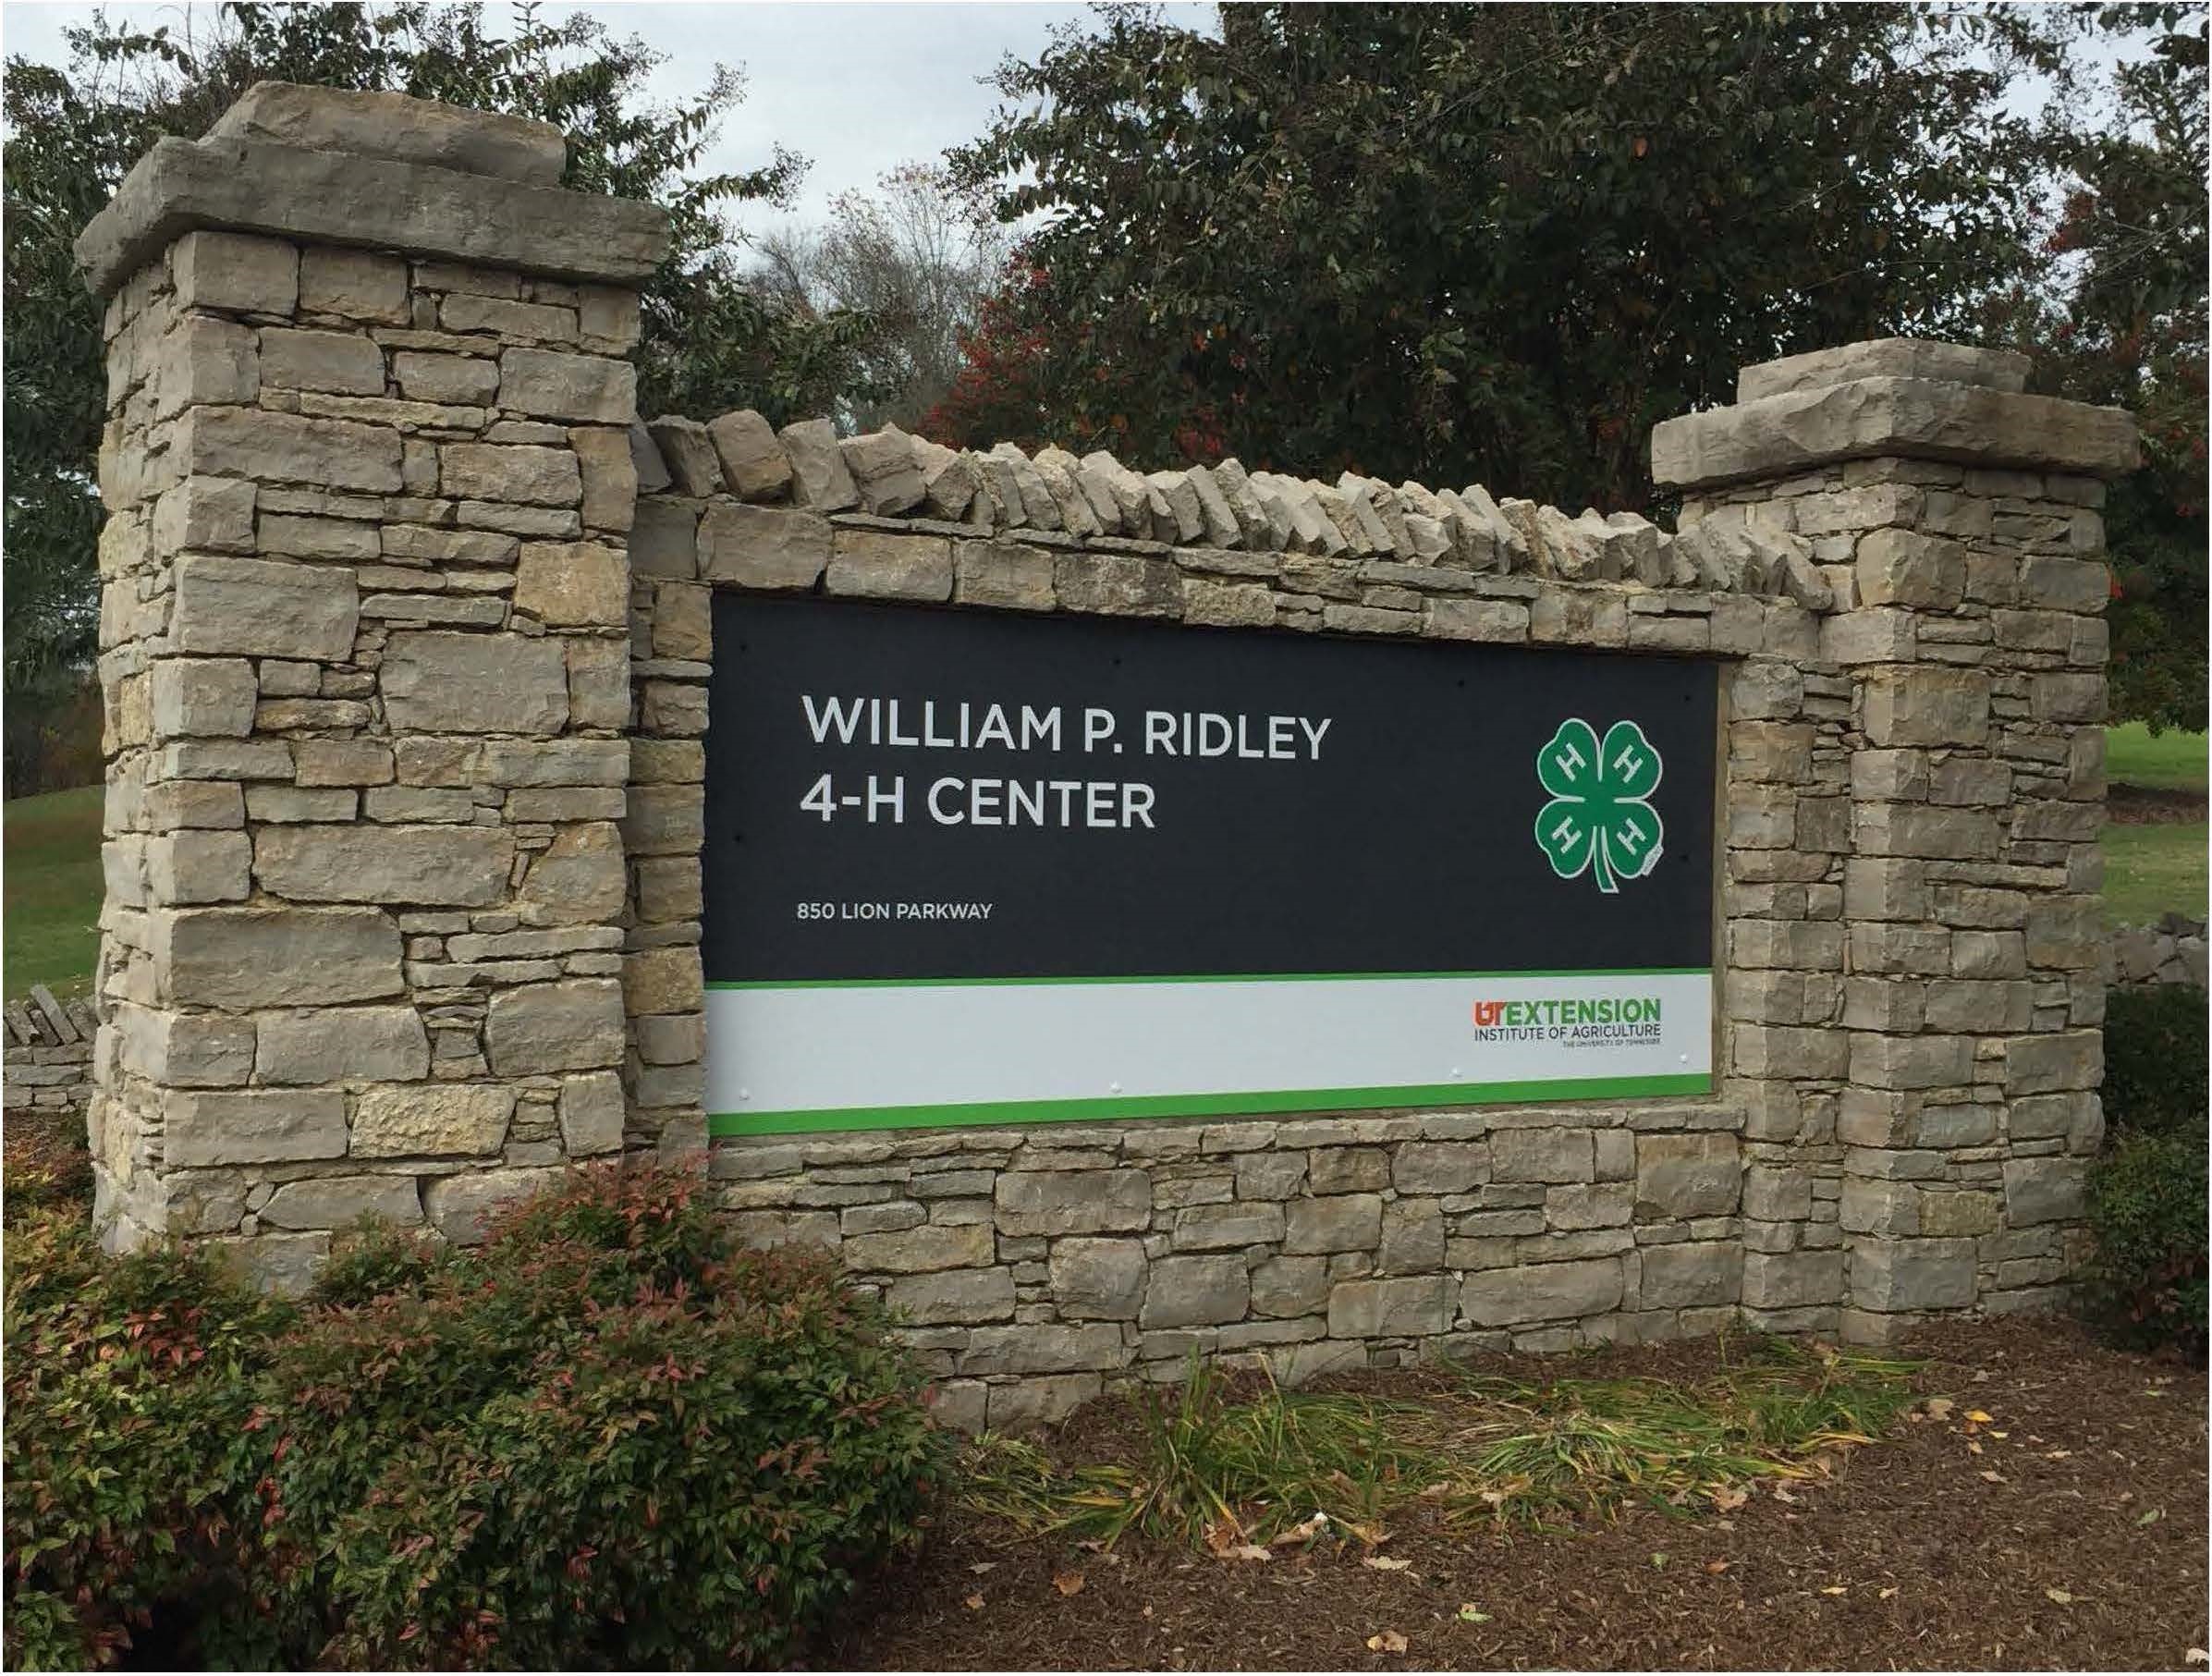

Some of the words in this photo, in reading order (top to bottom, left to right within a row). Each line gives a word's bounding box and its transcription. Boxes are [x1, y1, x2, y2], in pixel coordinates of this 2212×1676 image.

[801, 694, 1061, 752] WILLIAM
[1084, 708, 1123, 753] P.
[1145, 710, 1332, 760] RIDLEY
[1555, 742, 1586, 782] H
[1613, 745, 1644, 783] H
[800, 773, 904, 824] 4-H
[927, 777, 1155, 828] CENTER
[1551, 816, 1582, 853] H
[1617, 818, 1646, 855] H
[796, 902, 836, 920] 850
[841, 902, 890, 920] LION
[896, 902, 994, 920] PARKWAY
[1474, 1027, 1545, 1042] INSTITUTE
[1547, 1026, 1568, 1040] OF
[1570, 1023, 1661, 1038] AGRICULTURE
